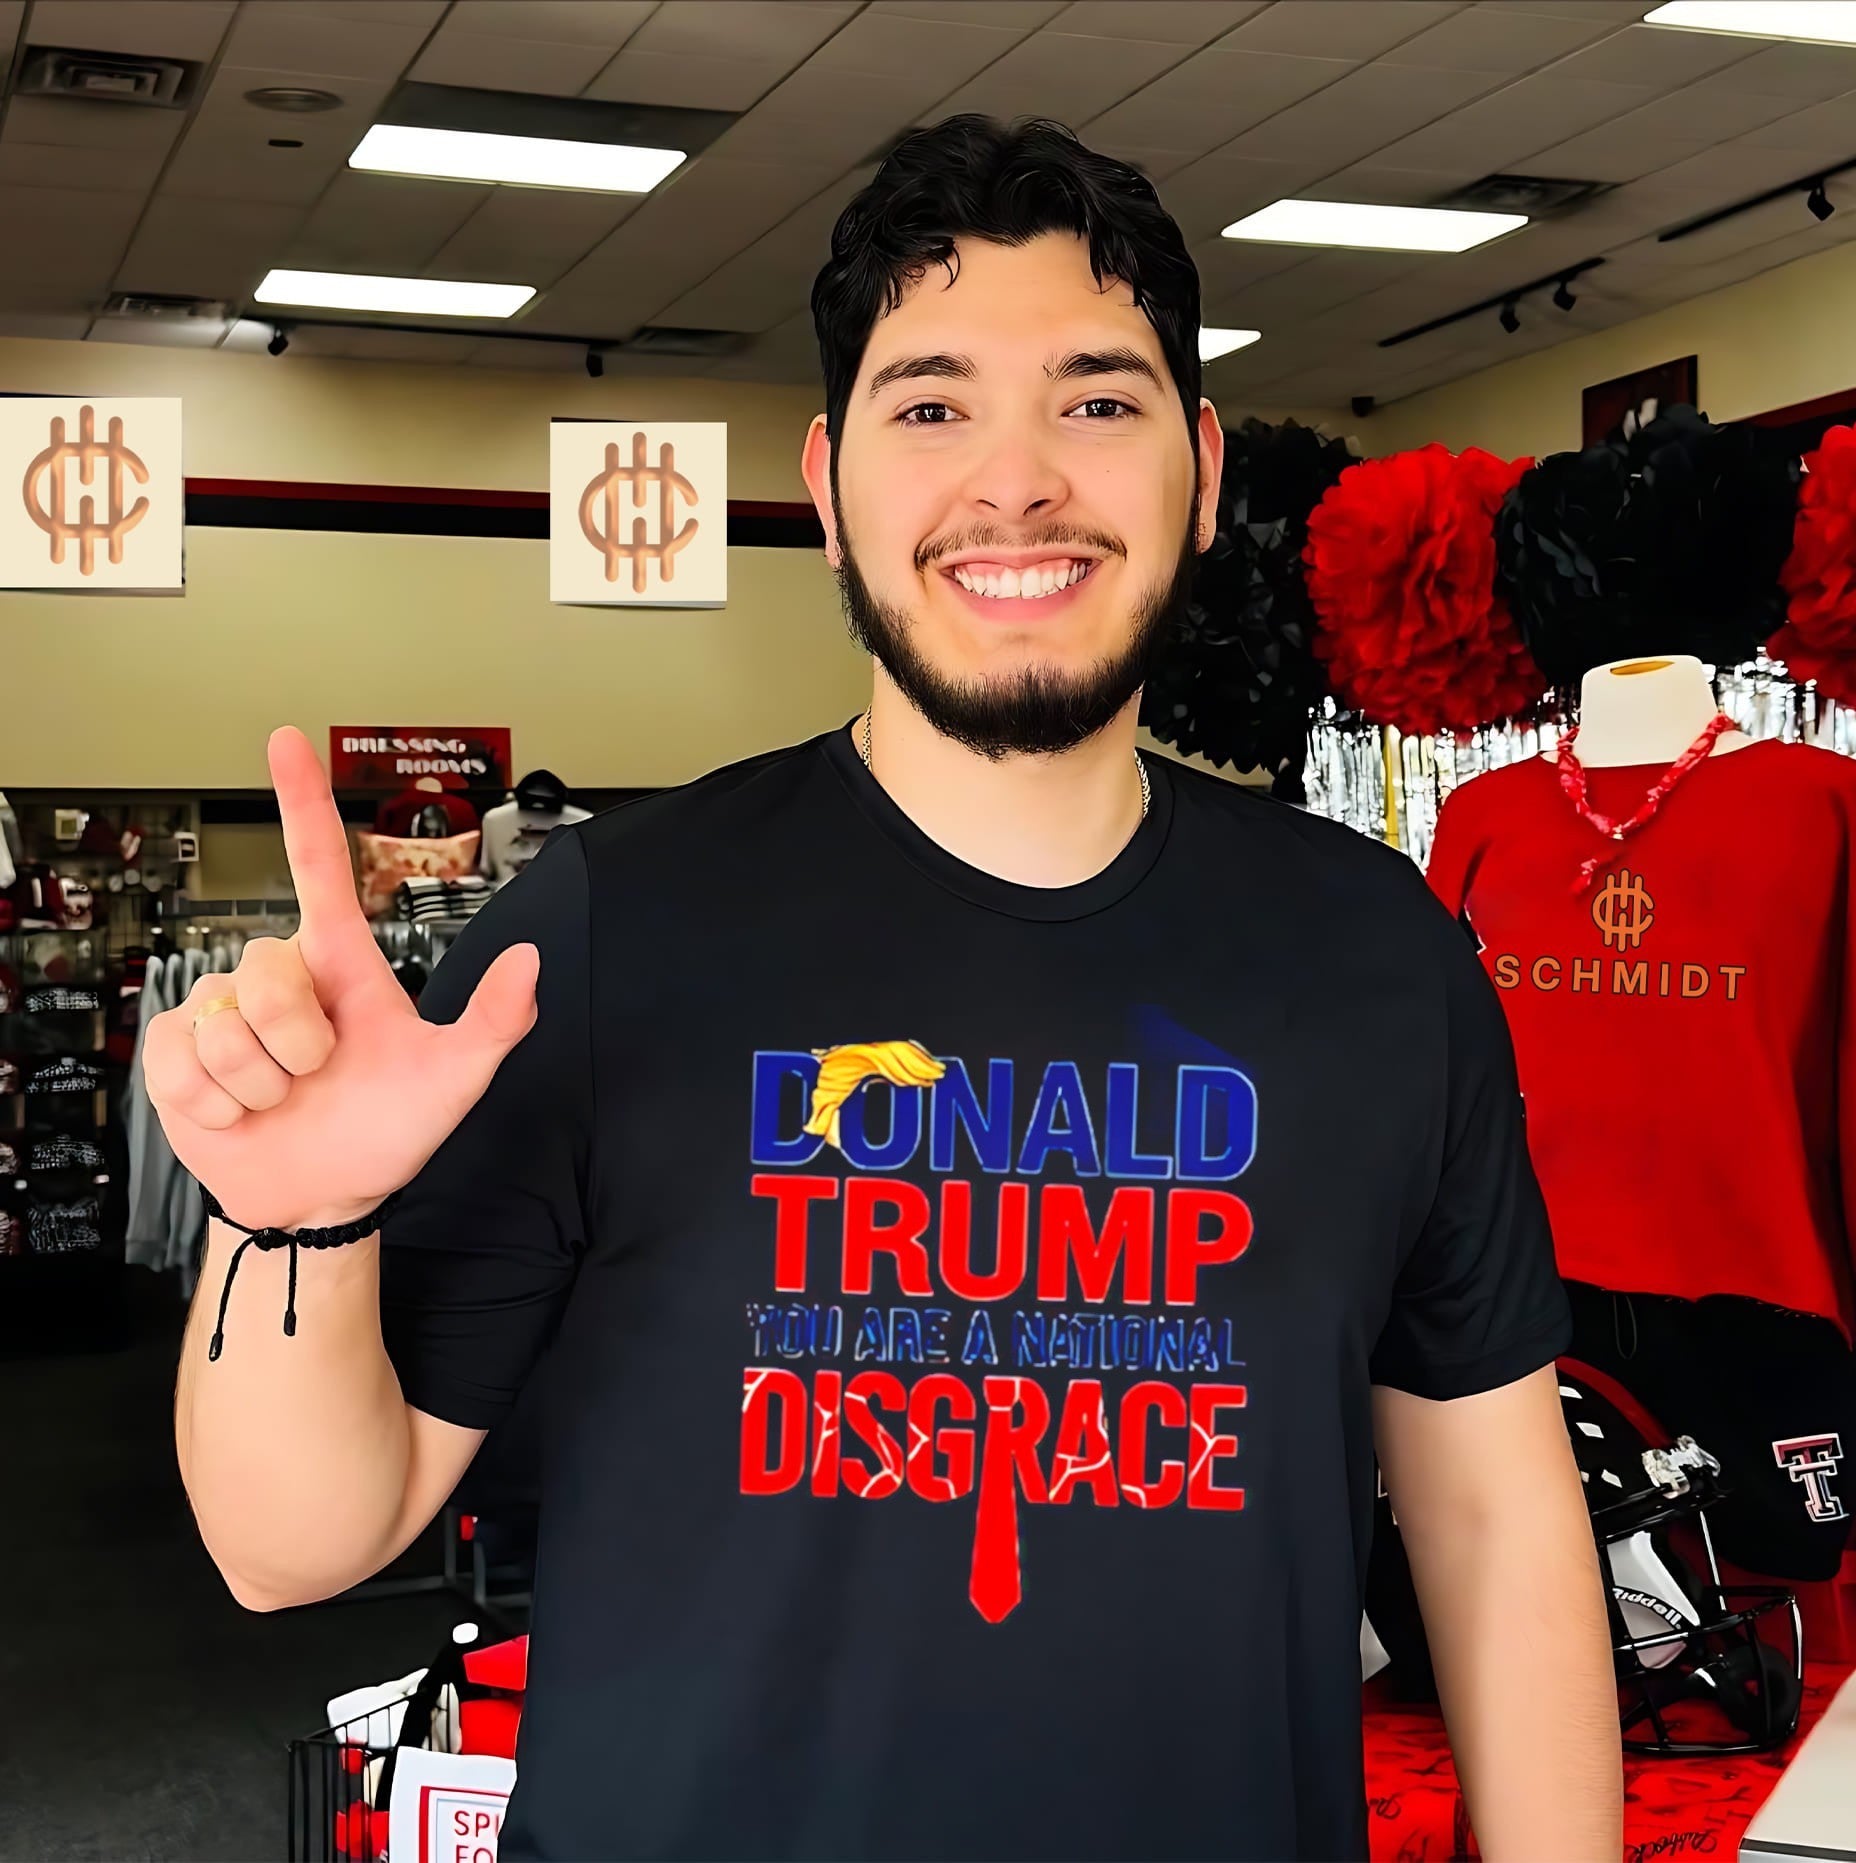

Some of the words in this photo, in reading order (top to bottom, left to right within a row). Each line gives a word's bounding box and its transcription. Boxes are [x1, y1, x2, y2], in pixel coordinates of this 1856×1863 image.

[342, 737, 467, 754] DRESSING
[396, 758, 487, 775] ROOMS
[1494, 953, 1747, 1001] SCHMIDT
[750, 1050, 1258, 1181] DONALD
[750, 1173, 1254, 1306] TRUMP
[746, 1302, 843, 1359] YOU
[854, 1307, 951, 1364] ARE
[960, 1310, 999, 1366] A
[1011, 1311, 1247, 1372] NATIONAL
[739, 1366, 1248, 1511] DISGRACE
